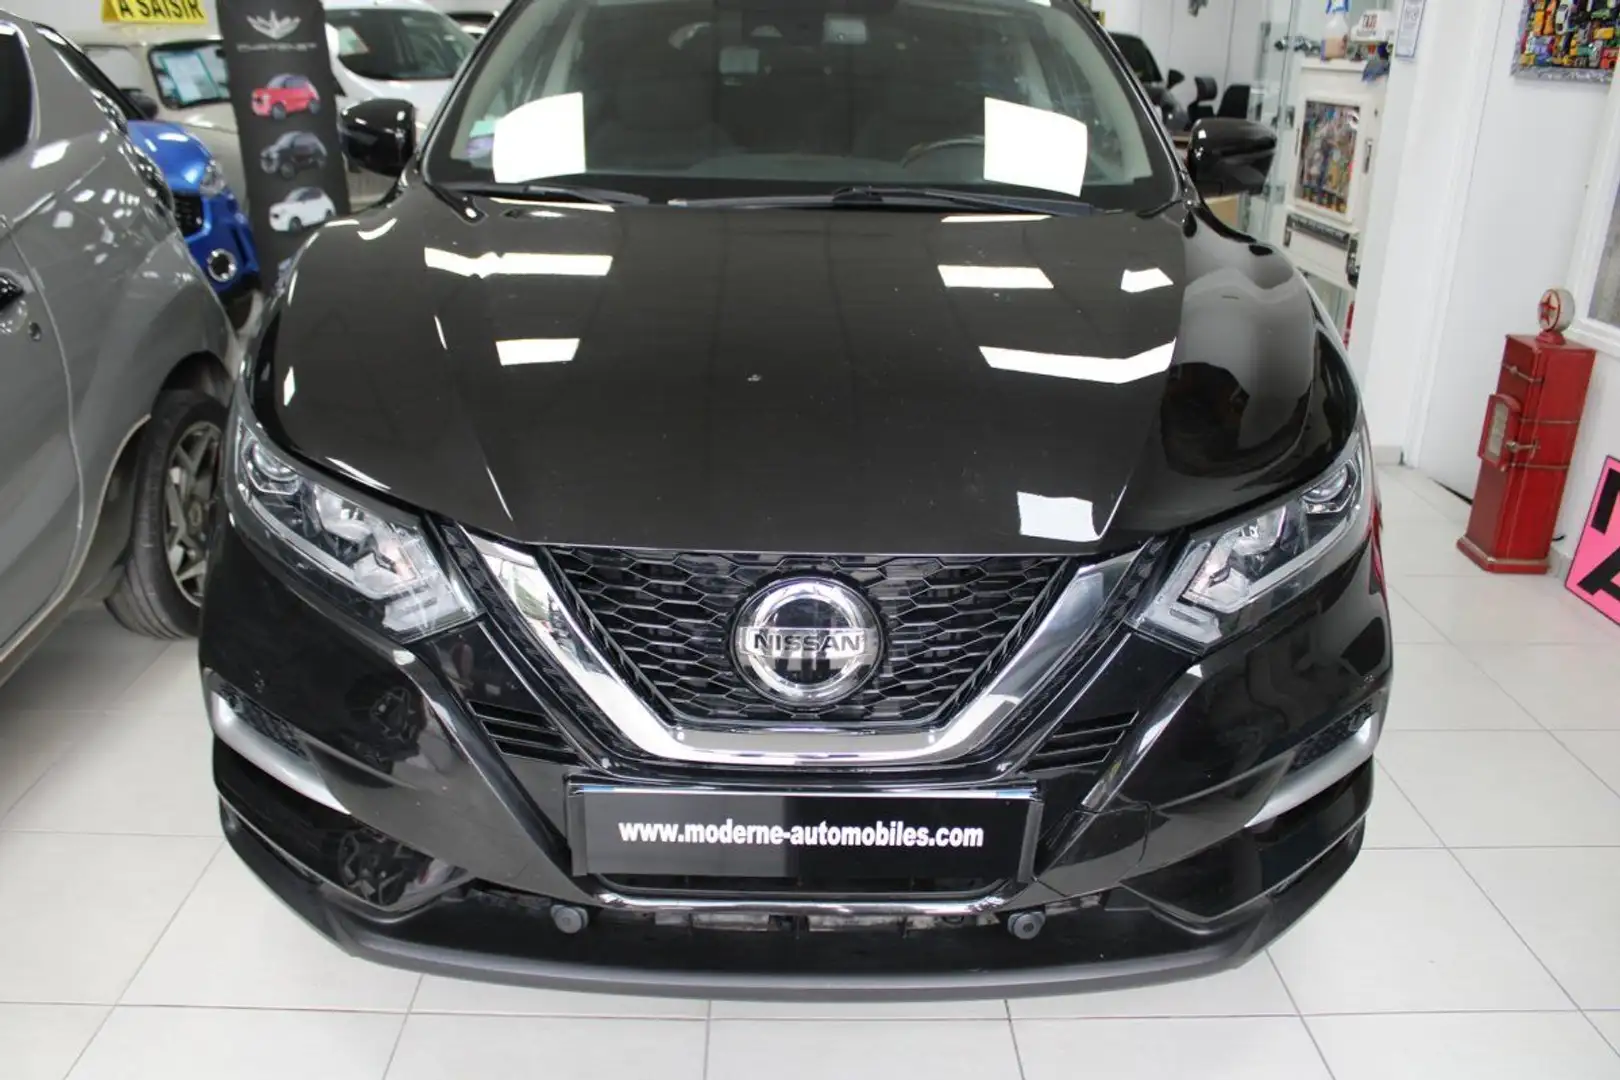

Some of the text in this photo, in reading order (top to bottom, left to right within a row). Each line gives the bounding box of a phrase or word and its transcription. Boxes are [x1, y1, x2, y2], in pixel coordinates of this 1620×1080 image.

[136, 0, 205, 18] SAISIR
[753, 632, 861, 652] NISSAN
[618, 818, 984, 848] www.moderne-automobiles.com
